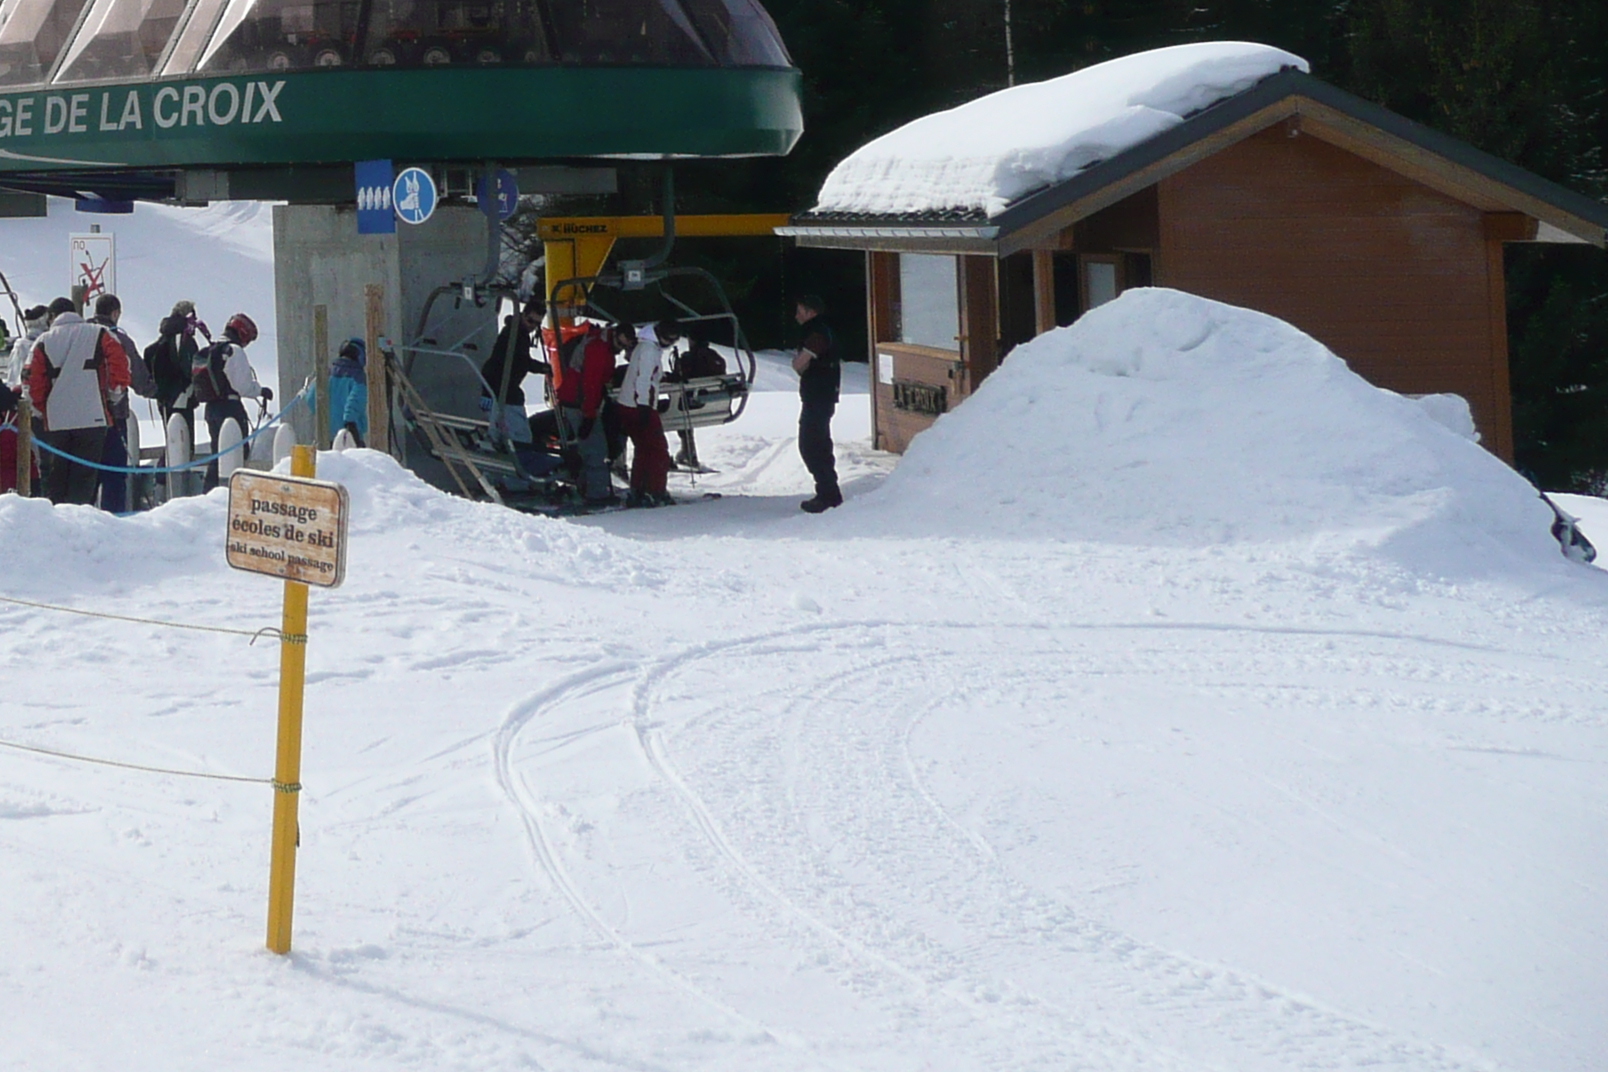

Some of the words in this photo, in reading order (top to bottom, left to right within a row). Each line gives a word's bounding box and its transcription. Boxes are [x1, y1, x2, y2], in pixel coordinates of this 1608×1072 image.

[44, 94, 90, 134] DE
[99, 90, 143, 131] LA
[153, 81, 286, 128] CROIX
[250, 498, 317, 524] passage
[232, 514, 281, 538] écoles
[284, 525, 304, 543] de
[307, 529, 334, 549] ski
[231, 542, 247, 554] ski
[249, 546, 285, 561] school
[287, 554, 334, 574] passage
